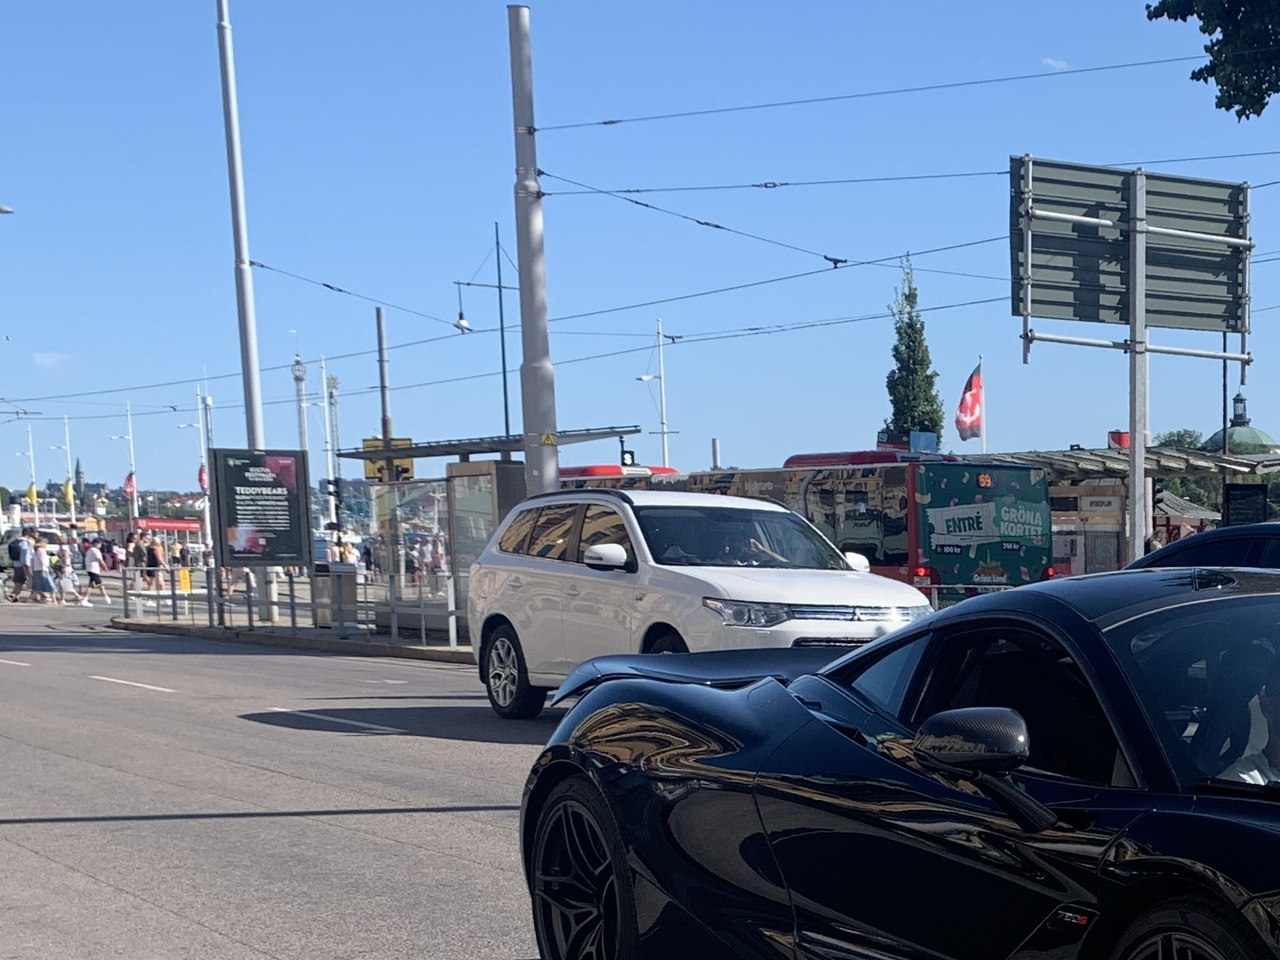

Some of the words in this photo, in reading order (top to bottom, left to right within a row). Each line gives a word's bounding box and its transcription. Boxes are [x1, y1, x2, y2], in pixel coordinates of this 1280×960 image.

[234, 486, 288, 495] TEDDYBEARS
[944, 511, 983, 535] ENTRÉ
[1001, 505, 1043, 526] GRÖNA
[1000, 521, 1043, 539] KORTET
